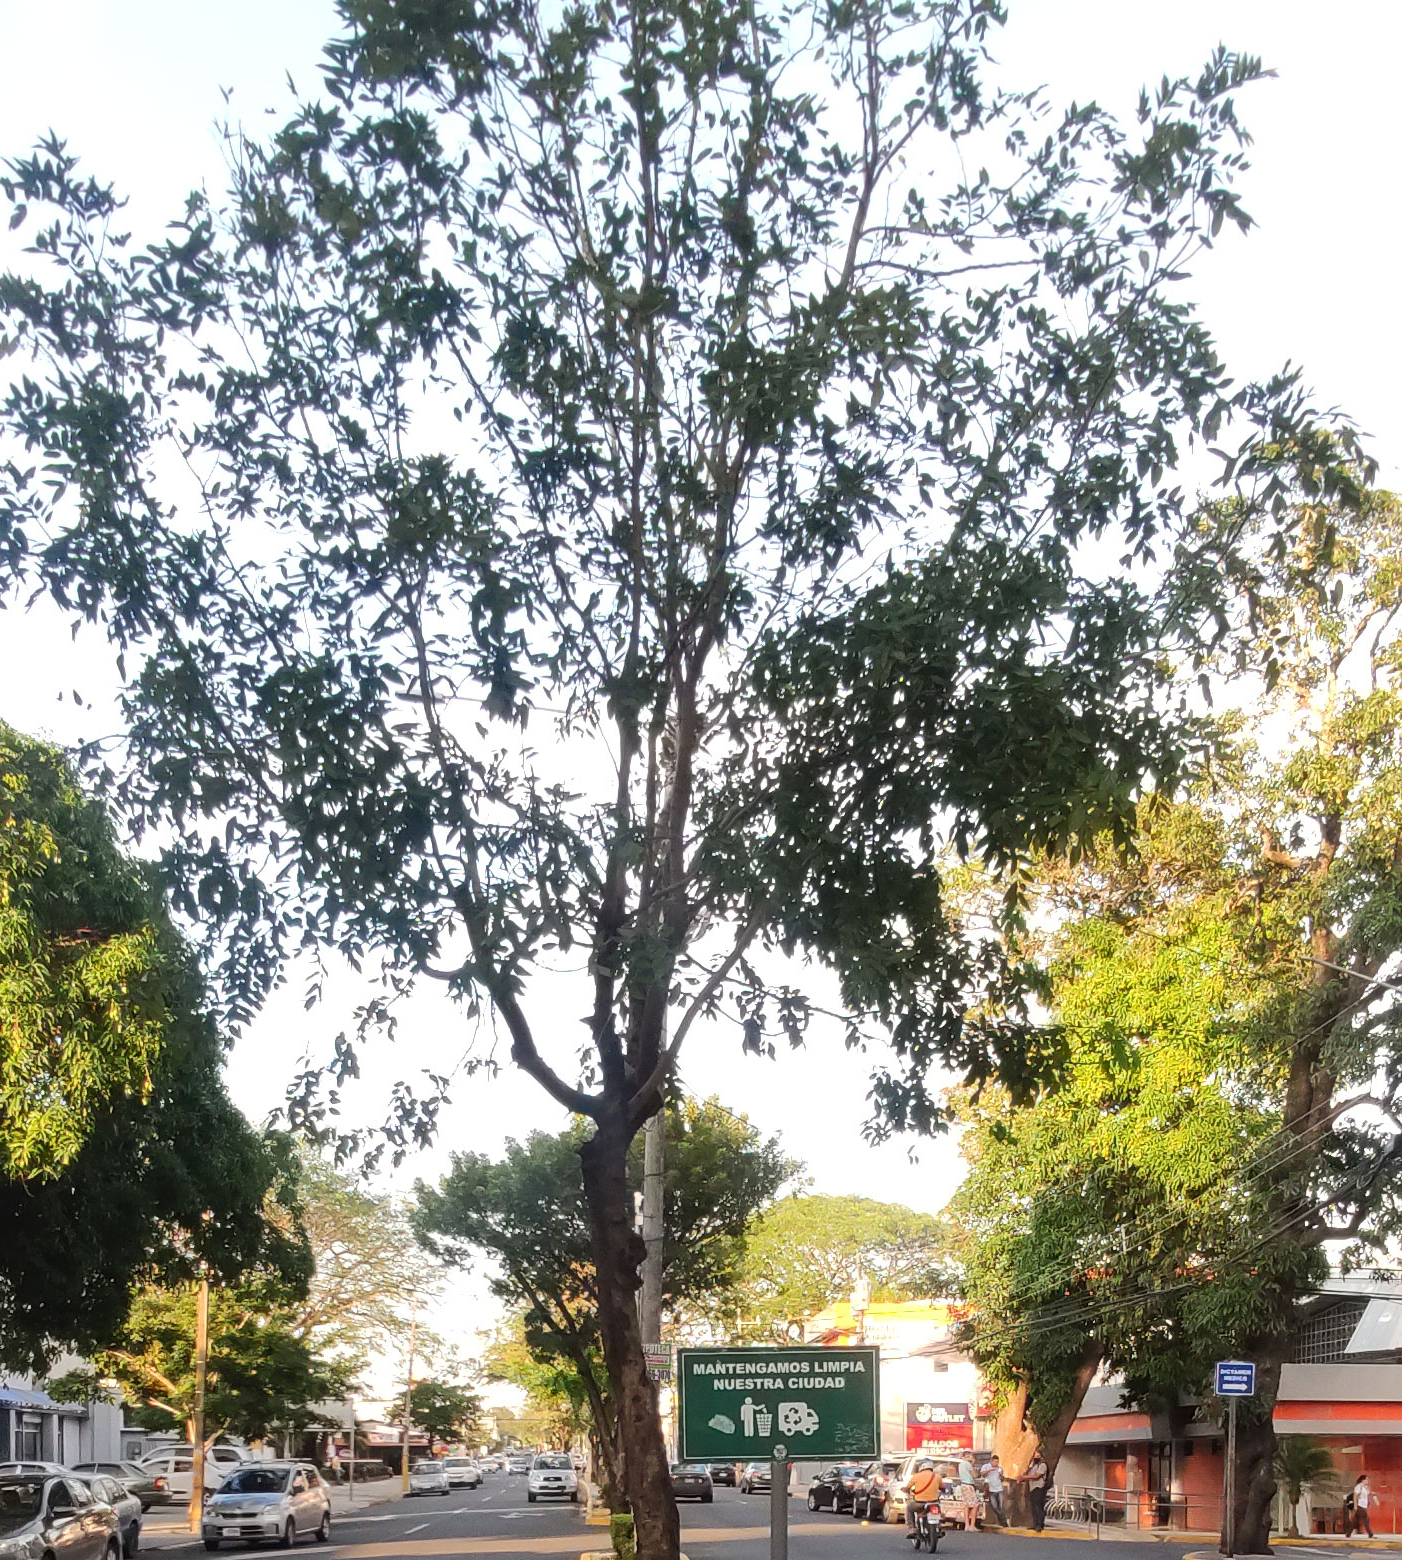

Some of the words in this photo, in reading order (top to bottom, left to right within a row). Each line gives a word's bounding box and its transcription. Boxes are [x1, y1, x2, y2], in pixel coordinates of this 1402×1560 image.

[693, 1361, 810, 1375] MANTENGAMOS
[814, 1361, 865, 1373] LIMPIA
[713, 1378, 784, 1390] NUESTRA
[788, 1377, 845, 1389] CIUDAD
